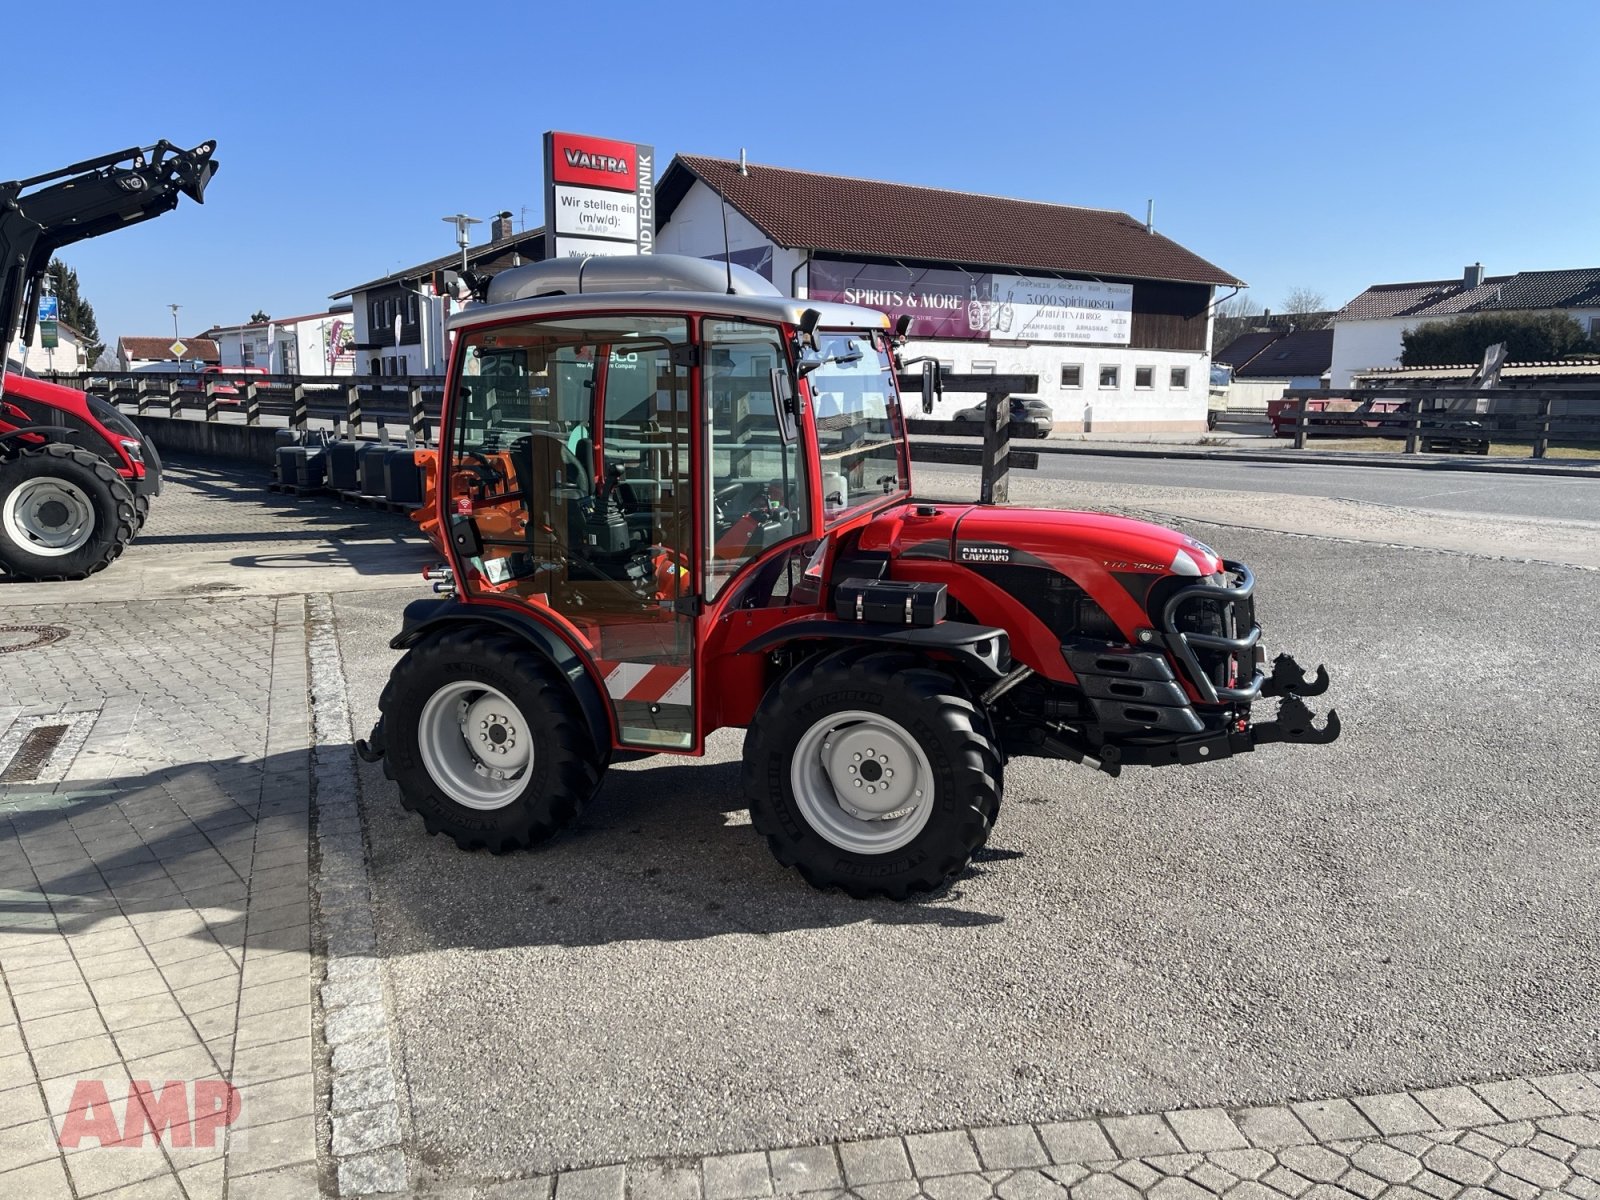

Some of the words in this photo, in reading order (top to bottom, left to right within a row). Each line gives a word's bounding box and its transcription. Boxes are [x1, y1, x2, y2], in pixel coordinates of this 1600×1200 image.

[564, 148, 628, 174] VALTRA
[561, 196, 580, 207] Wir
[584, 199, 618, 211] stellen
[621, 203, 636, 214] ein
[579, 212, 621, 228] (m/w/d):
[844, 287, 903, 307] SPIRITS
[906, 291, 918, 308] &
[919, 293, 963, 310] MORE
[1058, 295, 1114, 310] Spirituosen
[962, 553, 1009, 562] CARRARO
